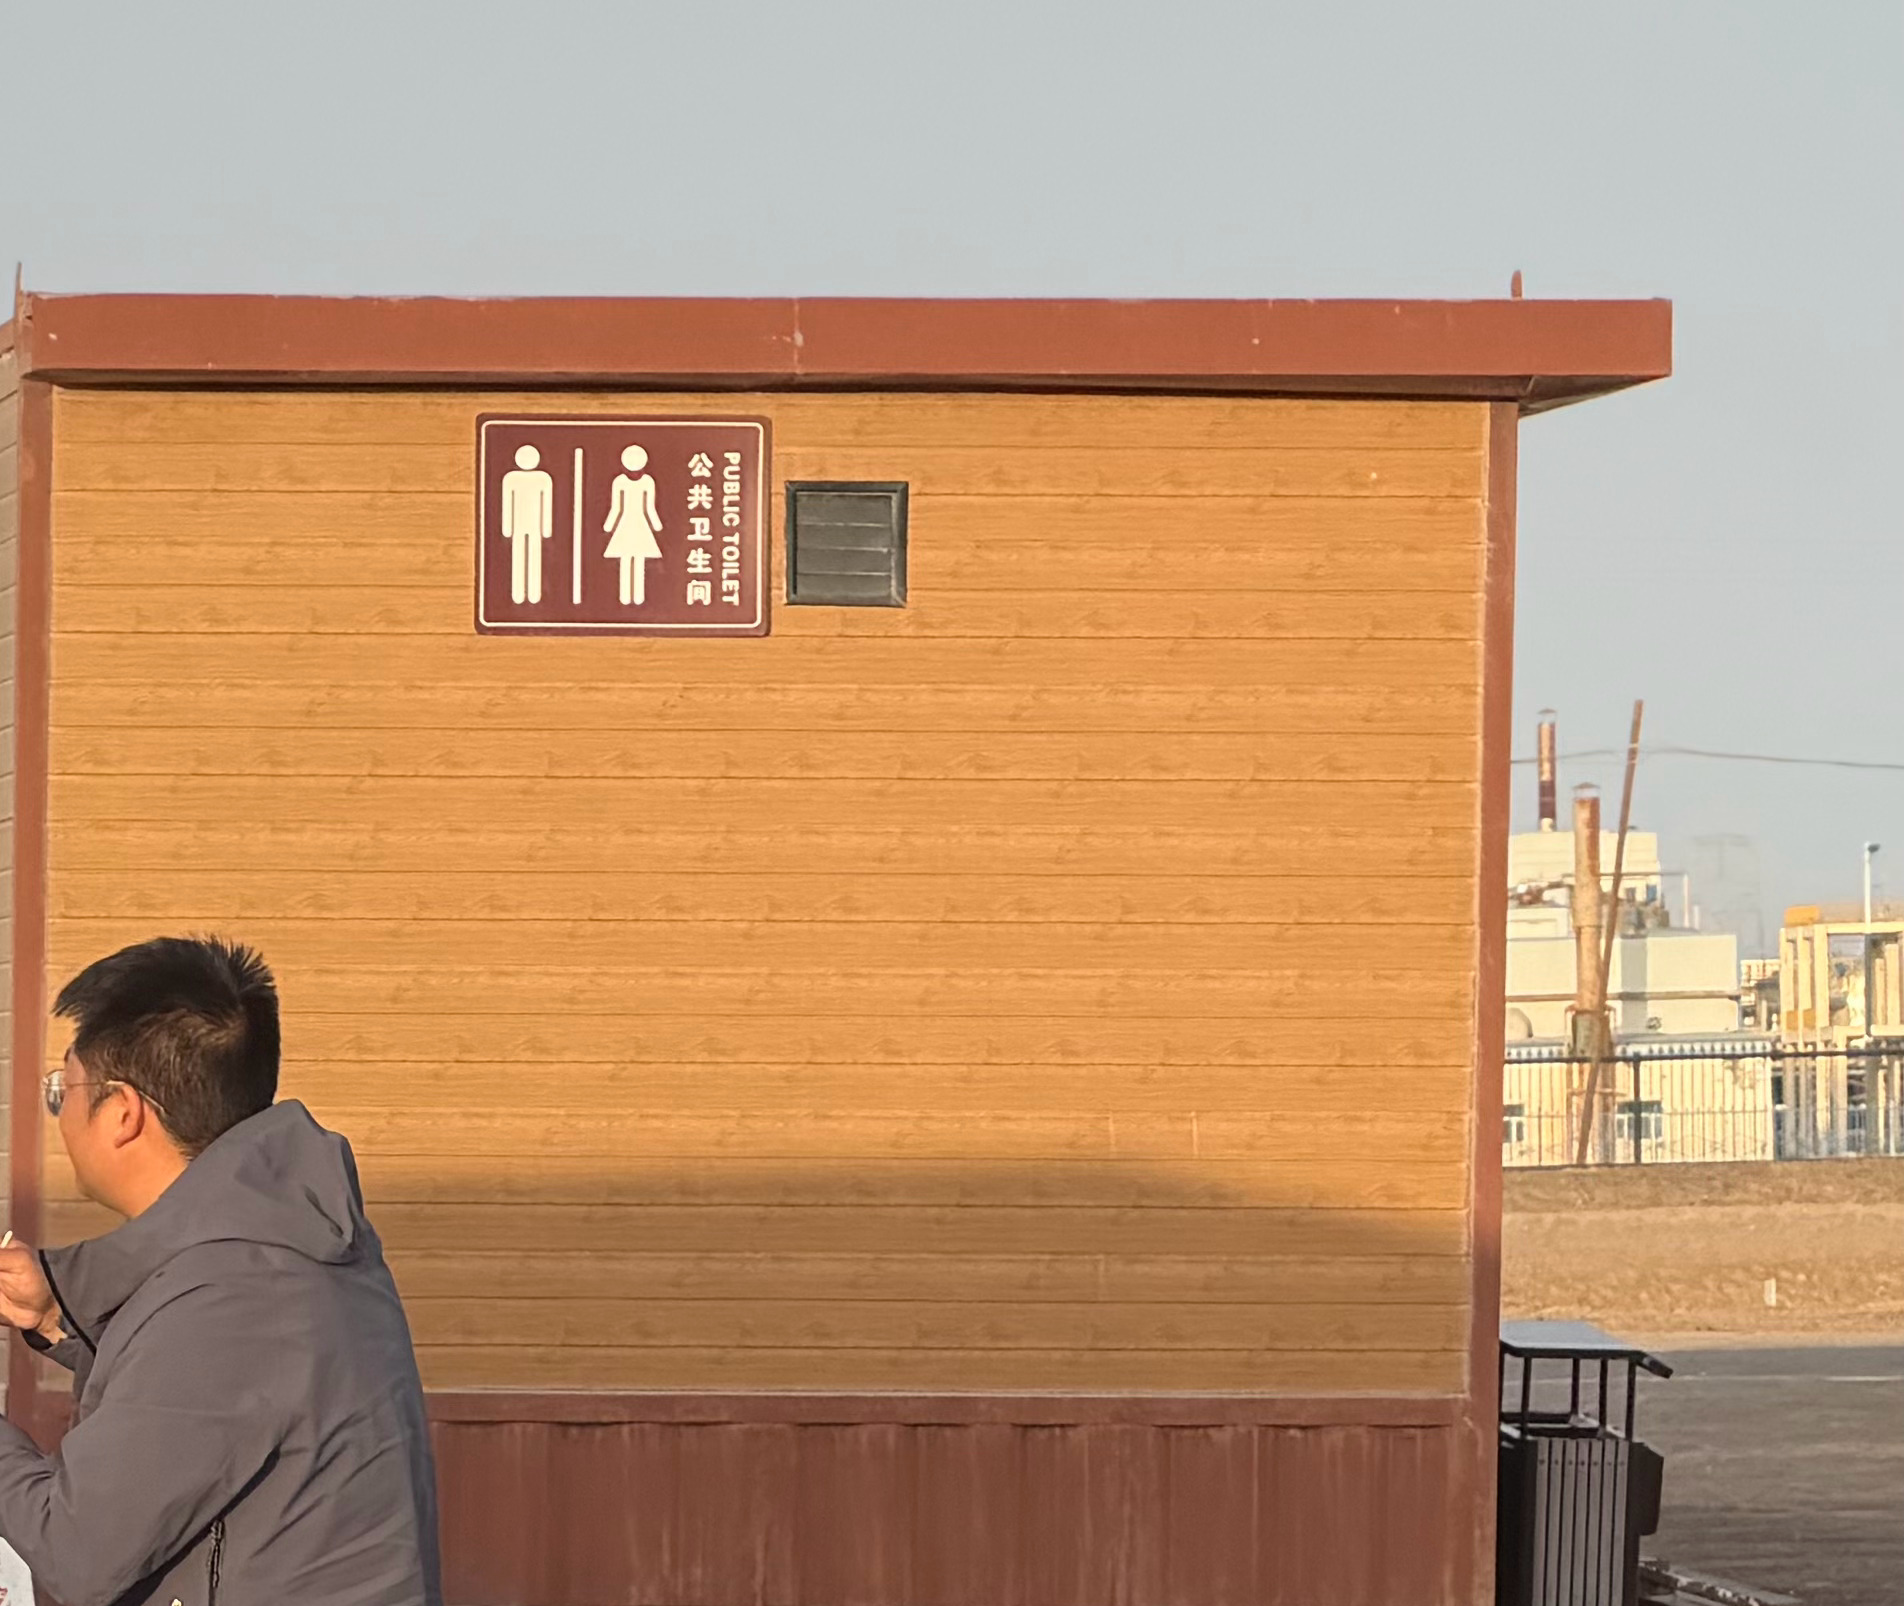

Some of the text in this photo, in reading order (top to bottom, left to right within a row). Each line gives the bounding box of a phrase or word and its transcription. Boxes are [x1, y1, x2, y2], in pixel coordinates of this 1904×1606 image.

[686, 452, 714, 606] 公共卫生间
[721, 452, 742, 606] PUBLIC TOILET
